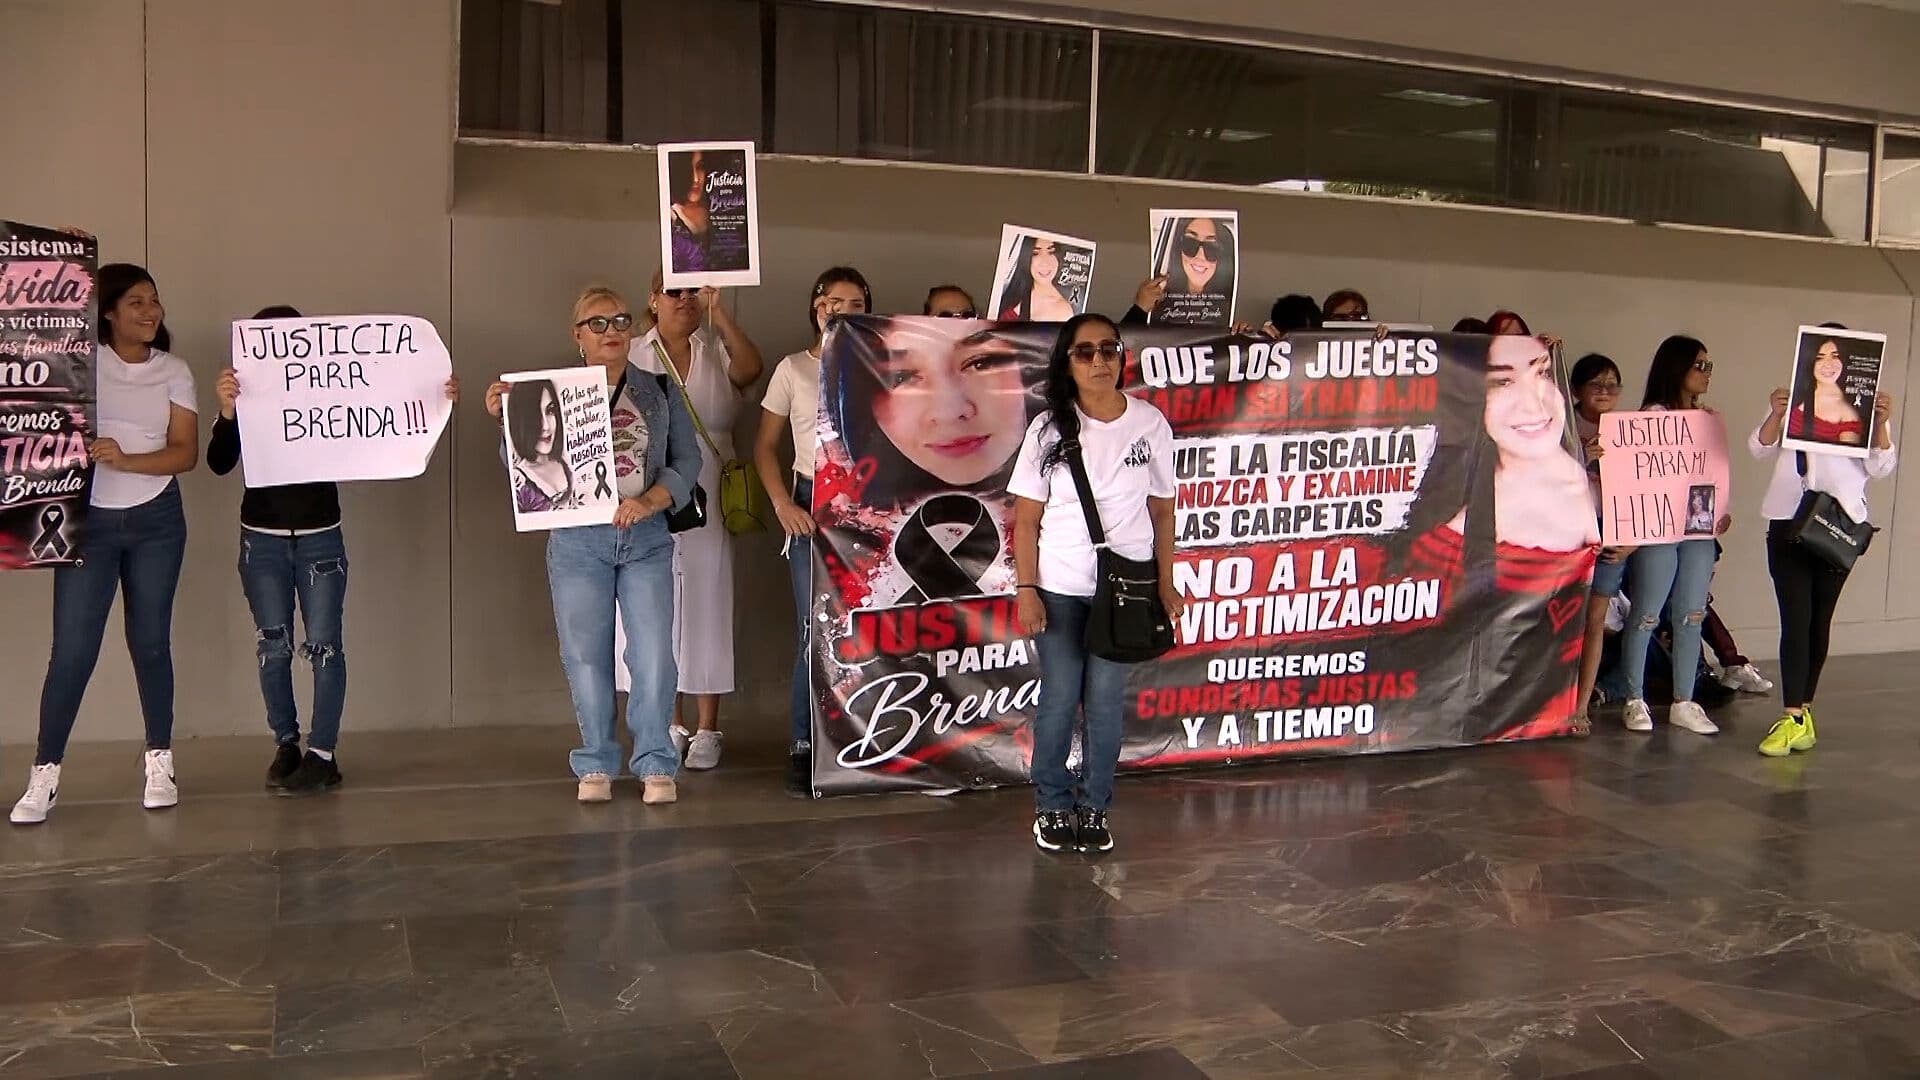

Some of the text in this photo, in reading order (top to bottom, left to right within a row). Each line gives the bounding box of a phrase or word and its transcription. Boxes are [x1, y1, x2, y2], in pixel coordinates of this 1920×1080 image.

[706, 170, 744, 193] Justicia
[0, 235, 84, 257] sistema
[1063, 251, 1090, 266] JUSTICIA
[1057, 267, 1088, 287] Brenda
[10, 312, 90, 330] víctimas,
[23, 333, 91, 361] familias
[239, 323, 419, 360] !JUSTICIA
[0, 360, 50, 387] no
[284, 361, 370, 392] PARA
[1141, 346, 1215, 388] QUE
[1228, 341, 1292, 382] LOS
[1305, 338, 1439, 379] JUECES
[560, 384, 599, 406] Por las que
[574, 405, 581, 413] no
[1246, 382, 1290, 417] SU
[1303, 376, 1438, 416] TRABAJO
[282, 399, 429, 442] BRENDA!!!
[1612, 415, 1694, 448] JUSTICIA
[1, 431, 88, 474] TICIA
[566, 427, 606, 452] hablamos
[571, 441, 607, 466] nosotras
[1173, 433, 1417, 479] UE LA FISCALÍA
[1635, 451, 1706, 480] PARA MI
[3, 469, 85, 503] Brenda
[1176, 465, 1416, 509] NOZCA Y EXAMINE
[1174, 499, 1383, 541] AS CARPETAS
[1613, 493, 1676, 541] HIJA
[1172, 547, 1356, 599] NO A LA
[1173, 577, 1440, 645] VICTIMIZACIÓN
[936, 639, 1028, 678] PARA
[1207, 651, 1366, 684] QUEREMOS
[1138, 671, 1418, 718] CONDENAS JUSTAS
[1182, 703, 1375, 748] Y A TIEMPO
